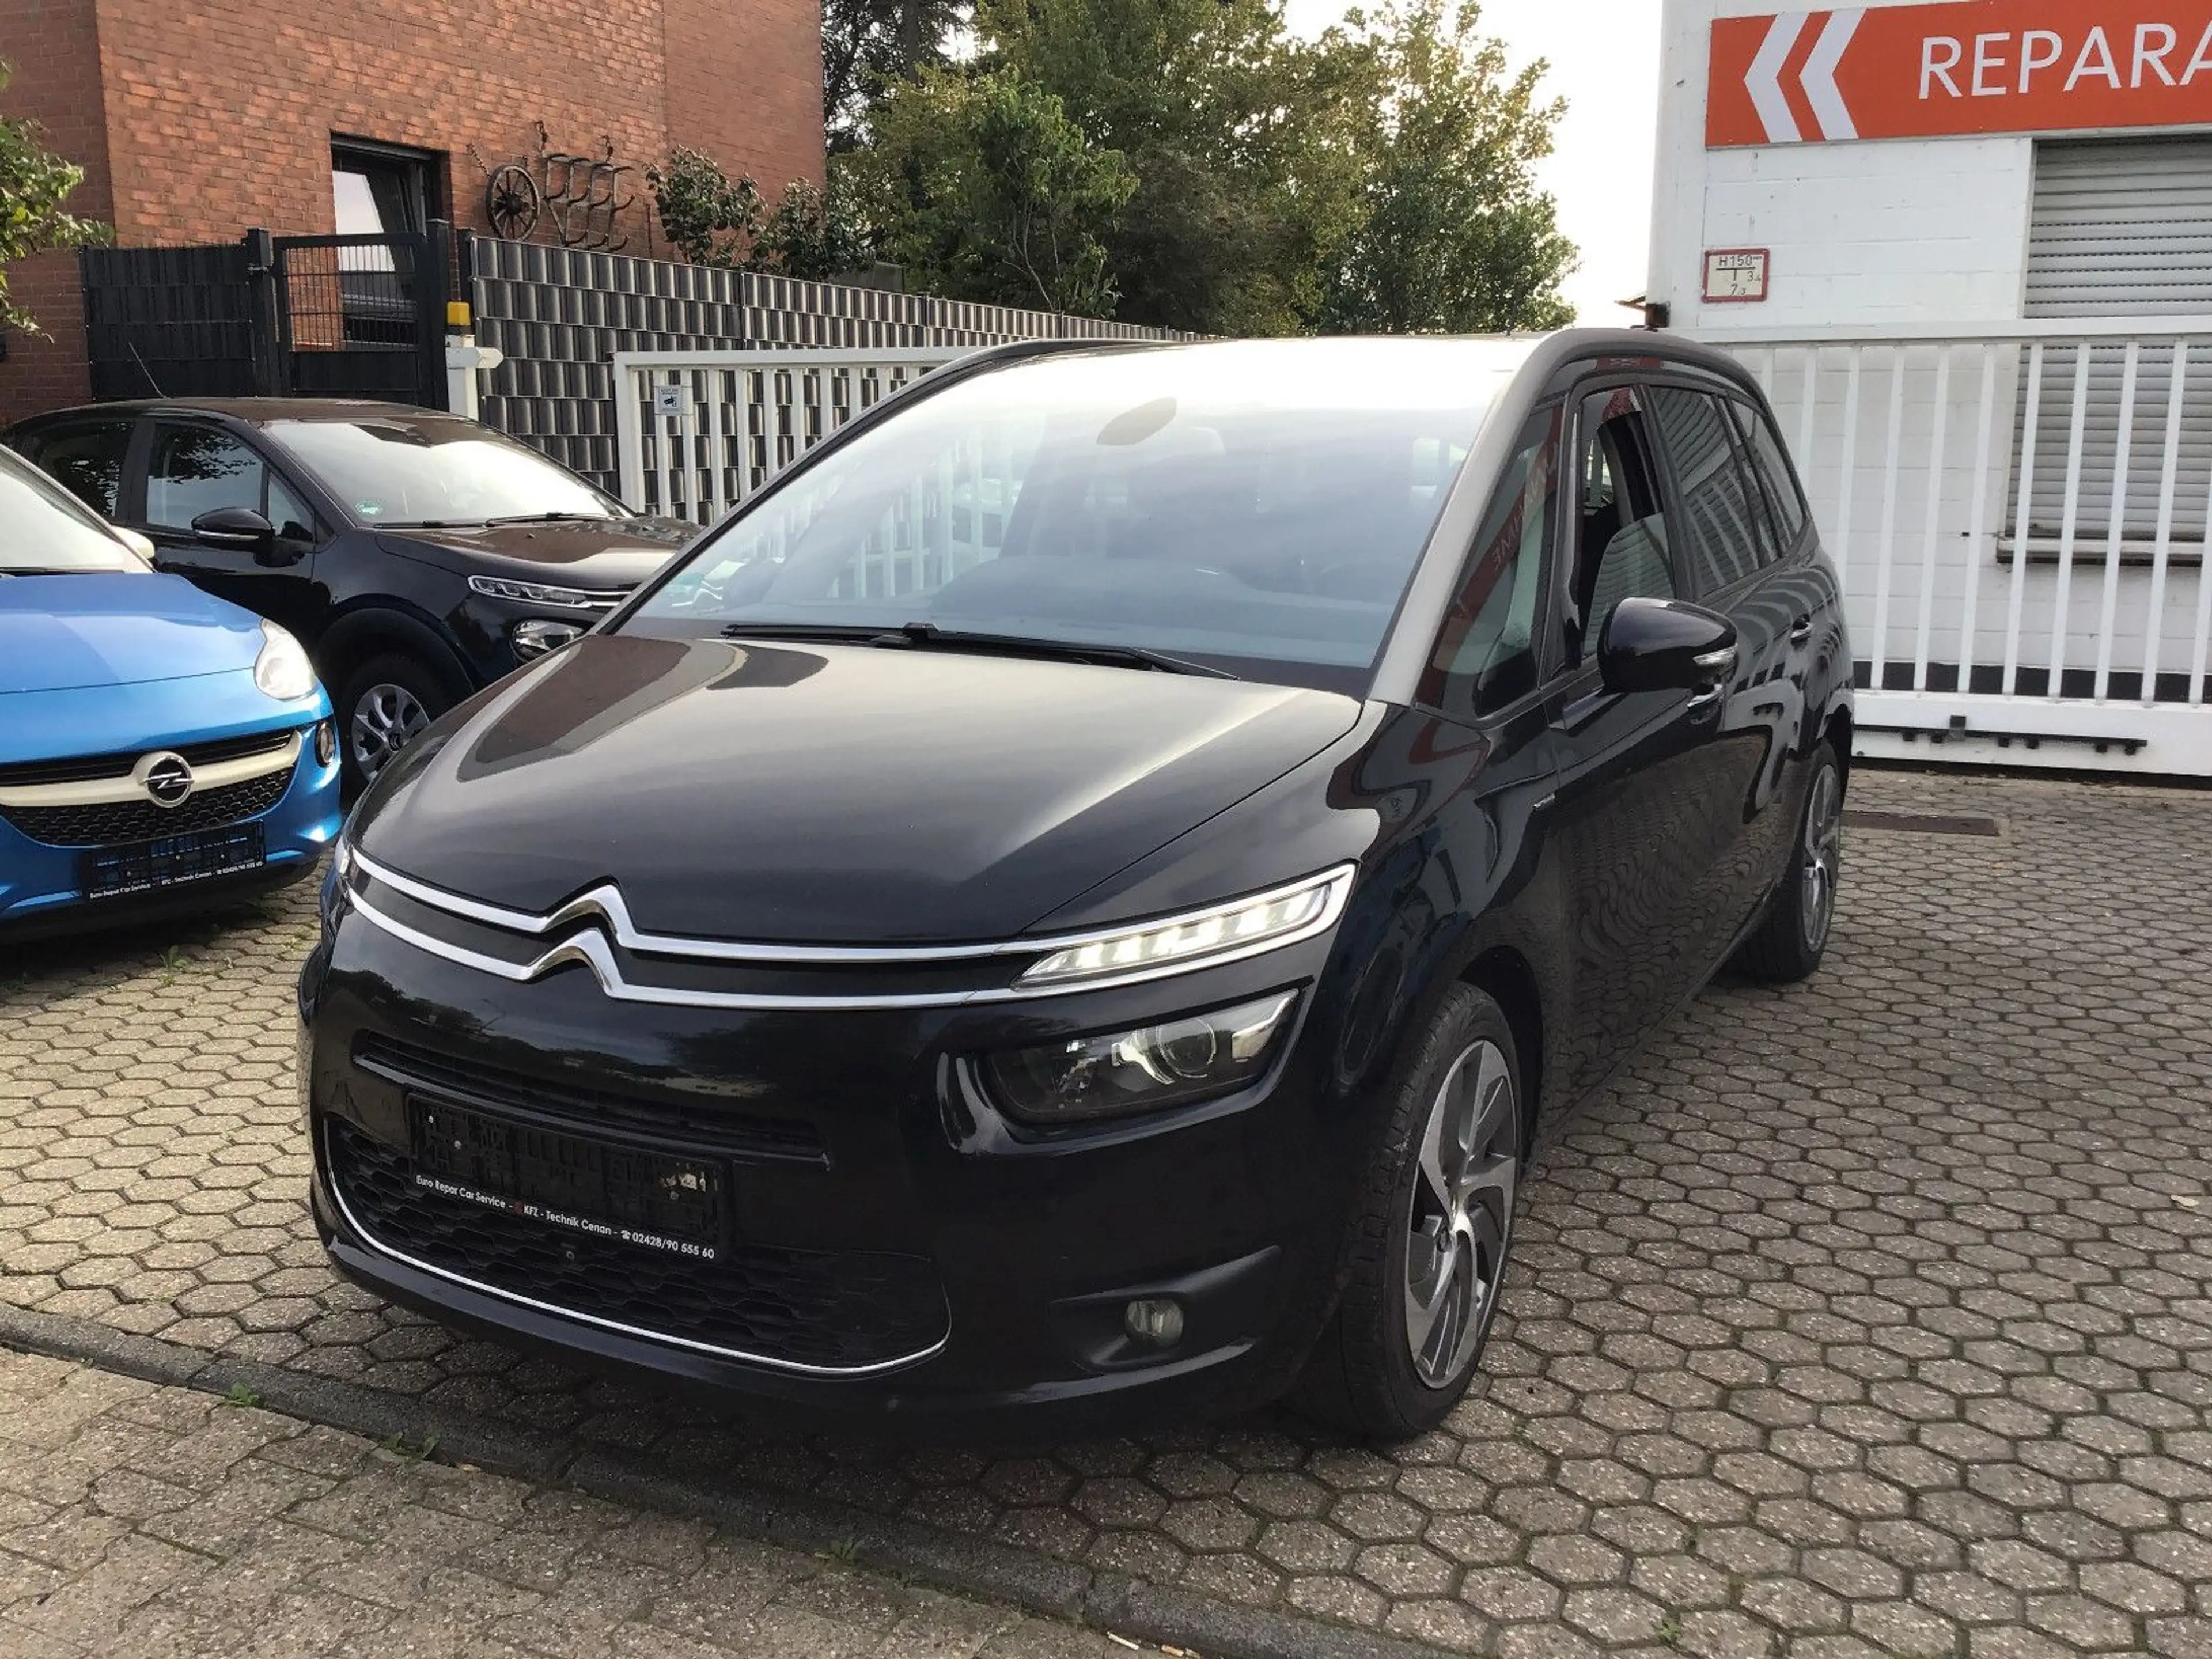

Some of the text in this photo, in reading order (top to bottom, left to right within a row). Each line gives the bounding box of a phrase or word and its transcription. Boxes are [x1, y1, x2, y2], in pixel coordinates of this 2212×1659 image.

[1919, 21, 2212, 99] REPARA
[416, 1175, 433, 1188] Euro
[459, 1187, 474, 1199] Car
[475, 1192, 506, 1208] Service
[524, 1204, 539, 1217] KFZ
[546, 1210, 579, 1228] Technik
[581, 1219, 612, 1235] Cenan
[632, 1232, 679, 1251] 02428/90
[681, 1243, 699, 1255] 555
[702, 1248, 714, 1259] 60
